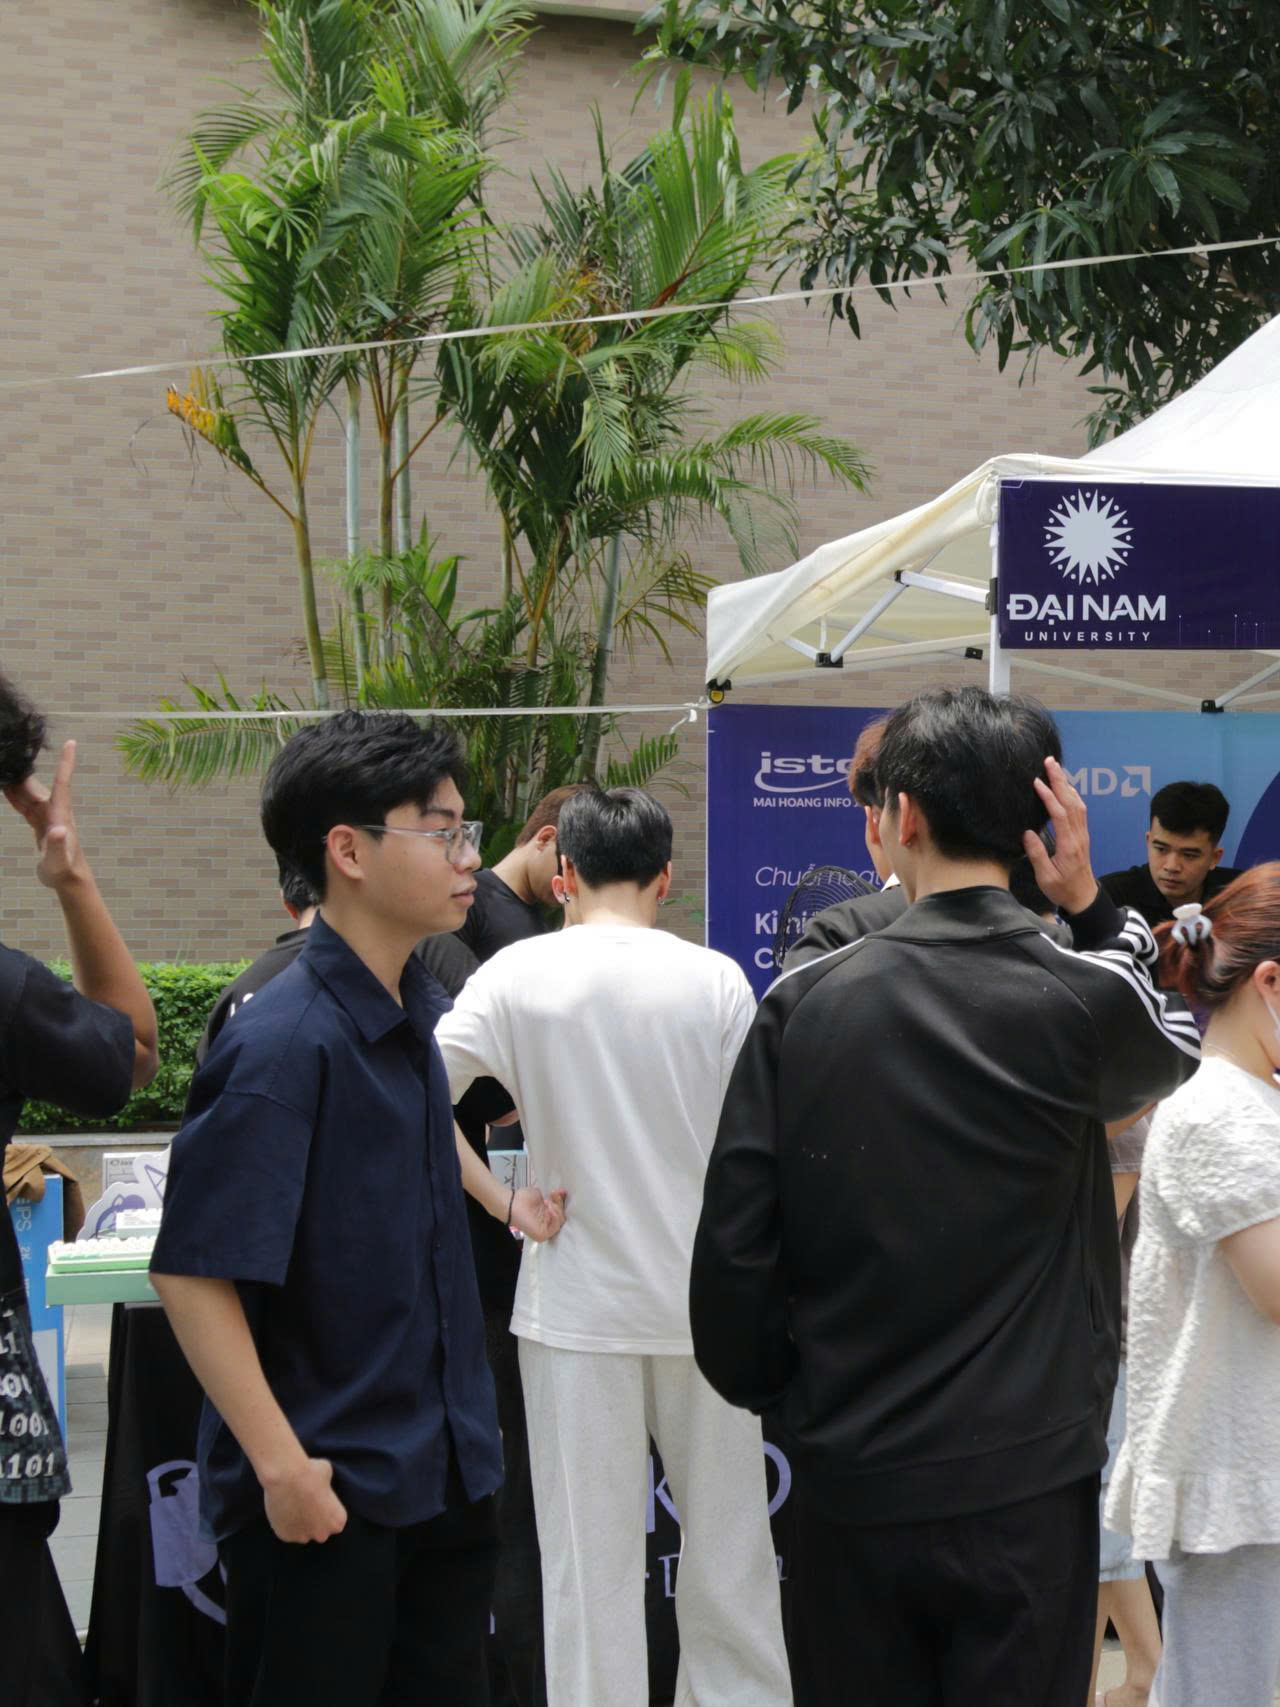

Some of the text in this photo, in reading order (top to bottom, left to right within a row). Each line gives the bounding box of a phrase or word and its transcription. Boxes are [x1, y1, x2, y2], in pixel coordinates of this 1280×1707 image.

[1006, 594, 1167, 625] ĐẠI NAM
[1024, 631, 1151, 642] UNIVERSITY
[1061, 767, 1118, 796] MD
[753, 797, 776, 807] MAI
[778, 797, 821, 807] HOANG
[823, 797, 852, 807] INFO
